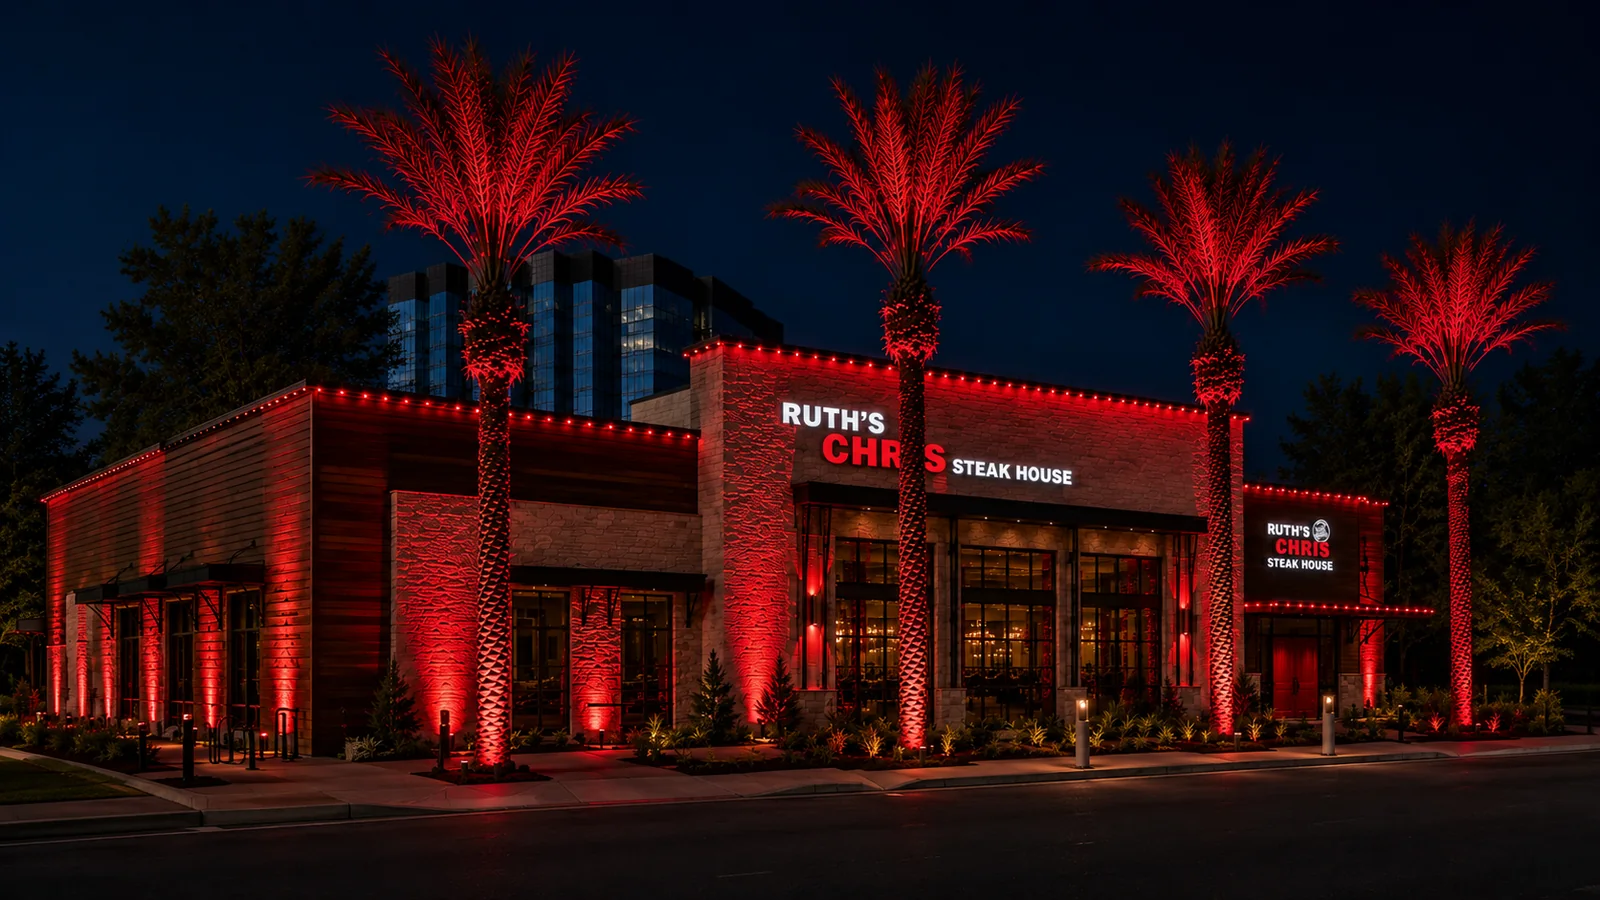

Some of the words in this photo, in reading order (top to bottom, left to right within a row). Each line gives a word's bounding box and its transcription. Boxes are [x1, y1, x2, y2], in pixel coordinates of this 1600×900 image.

[782, 402, 885, 434] RUTH'S
[822, 434, 947, 473] CHRS
[952, 459, 1011, 479] STEAK
[1016, 466, 1072, 485] HOUSE
[1267, 523, 1310, 538] RUTH'S
[1275, 538, 1330, 558] CHRIS
[1267, 557, 1299, 569] STEAK
[1301, 560, 1333, 571] HOUSE
